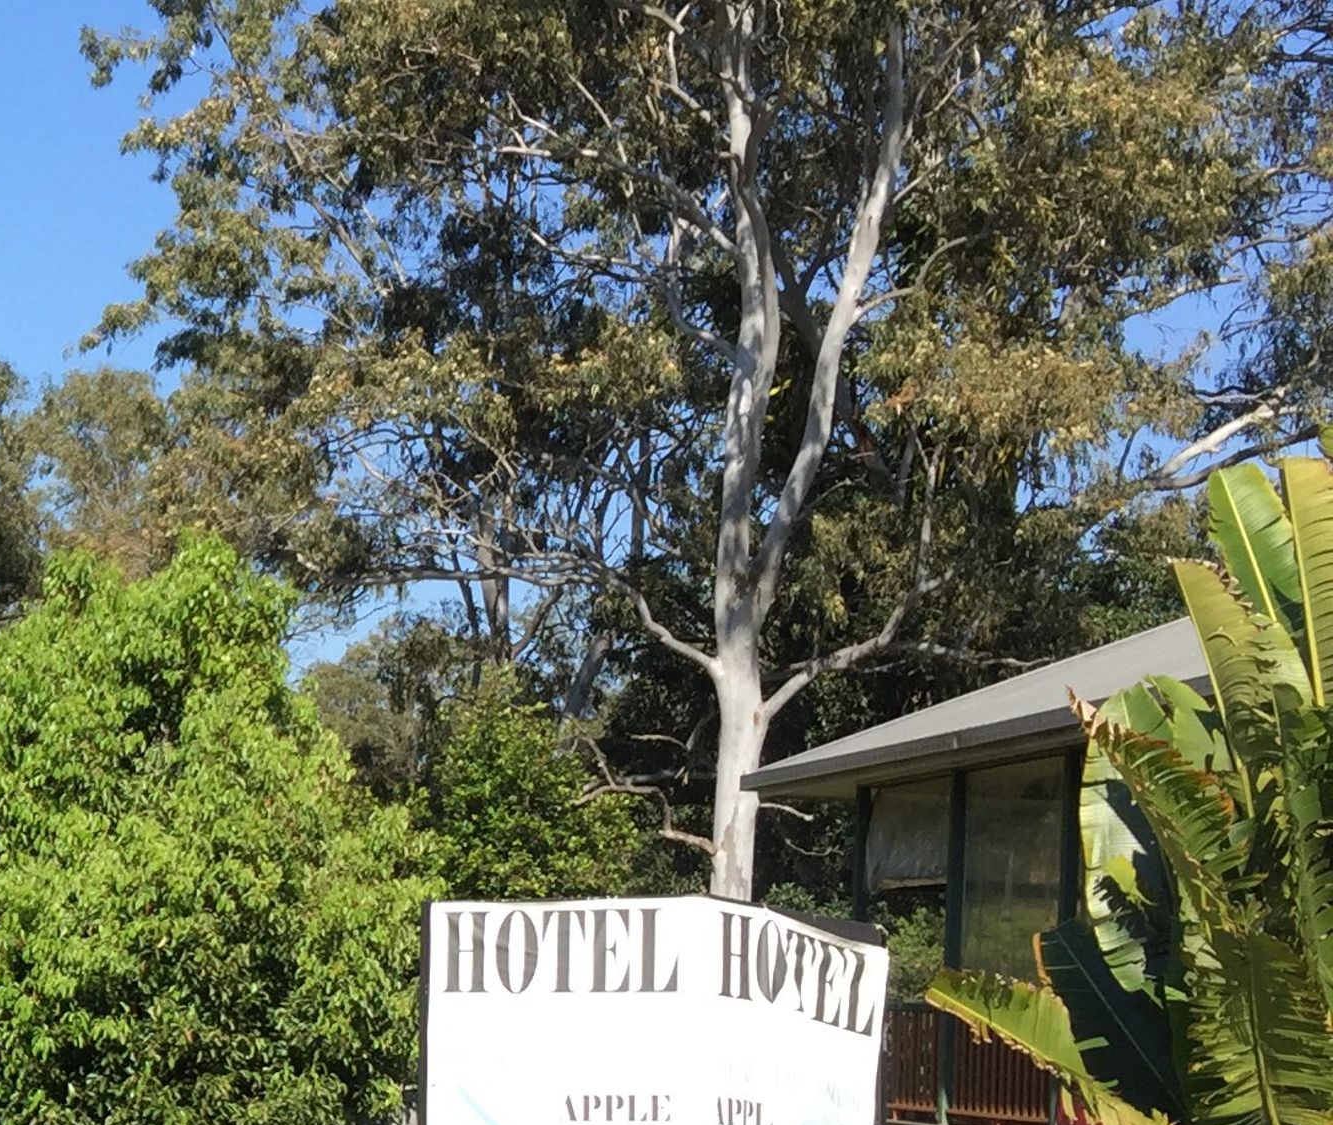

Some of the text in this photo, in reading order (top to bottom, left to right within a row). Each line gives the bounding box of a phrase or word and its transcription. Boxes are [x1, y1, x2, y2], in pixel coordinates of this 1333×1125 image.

[444, 909, 678, 994] HOTEL
[718, 910, 875, 1037] HOTEL
[565, 1095, 671, 1122] APPLE
